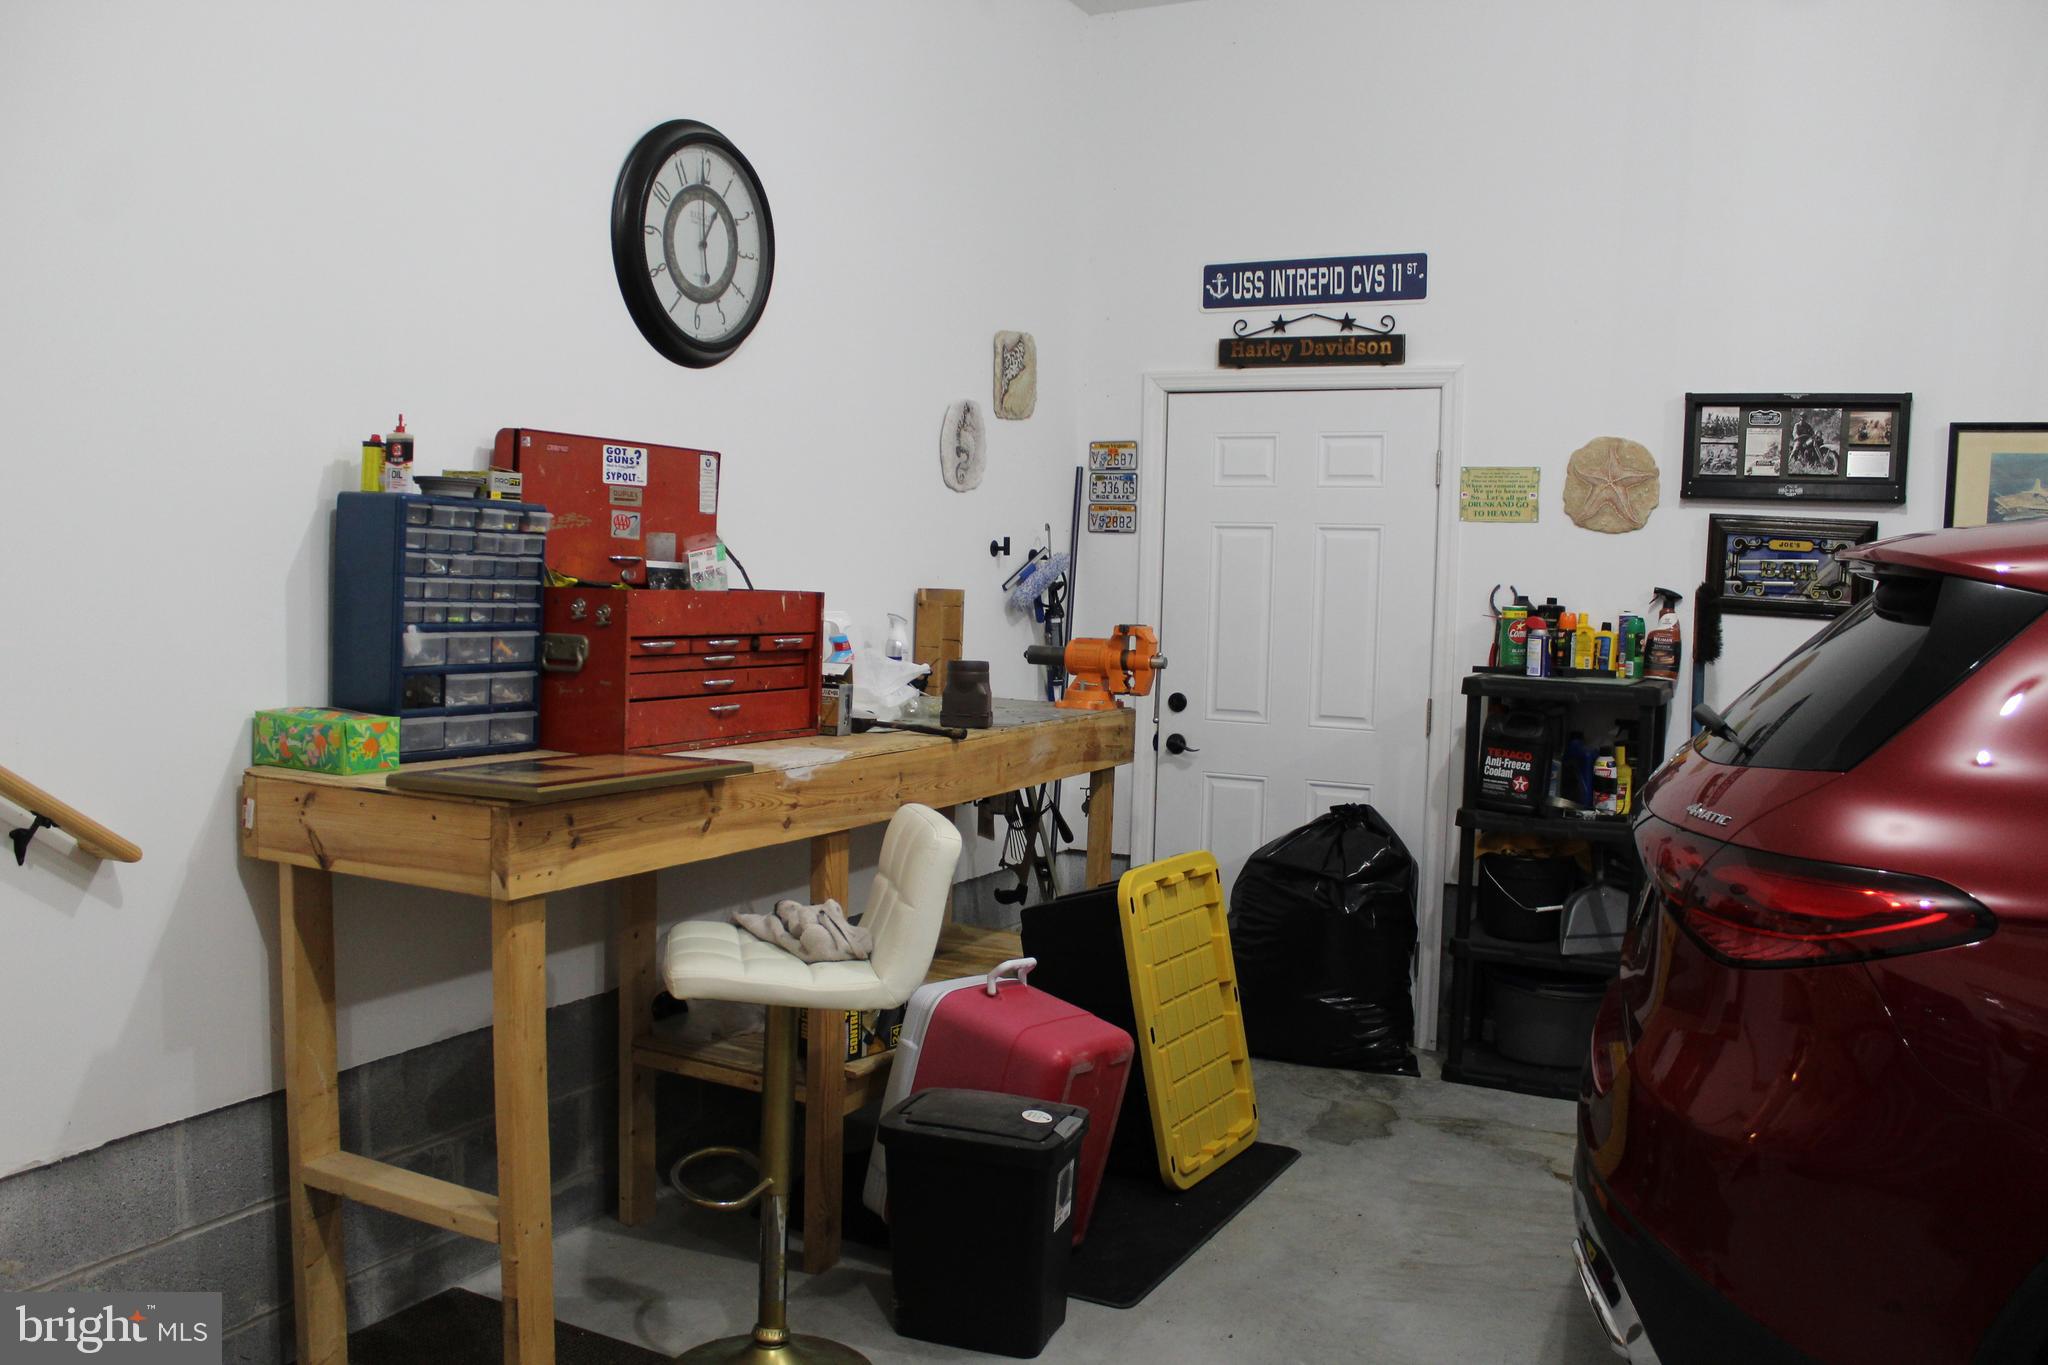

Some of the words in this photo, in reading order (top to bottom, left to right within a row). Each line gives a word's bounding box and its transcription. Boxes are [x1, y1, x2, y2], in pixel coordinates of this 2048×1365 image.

[675, 159, 688, 187] 11
[653, 180, 671, 208] 10
[1232, 270, 1264, 300] USS
[1271, 266, 1345, 297] INTREPID
[1352, 264, 1385, 294] CVS
[1231, 339, 1294, 361] Harley
[1301, 337, 1393, 357] Davidson
[606, 447, 627, 456] GOT
[606, 471, 637, 482] SYPOLT
[1484, 766, 1513, 778] Coolant
[1485, 756, 1531, 771] Anti-Freeze
